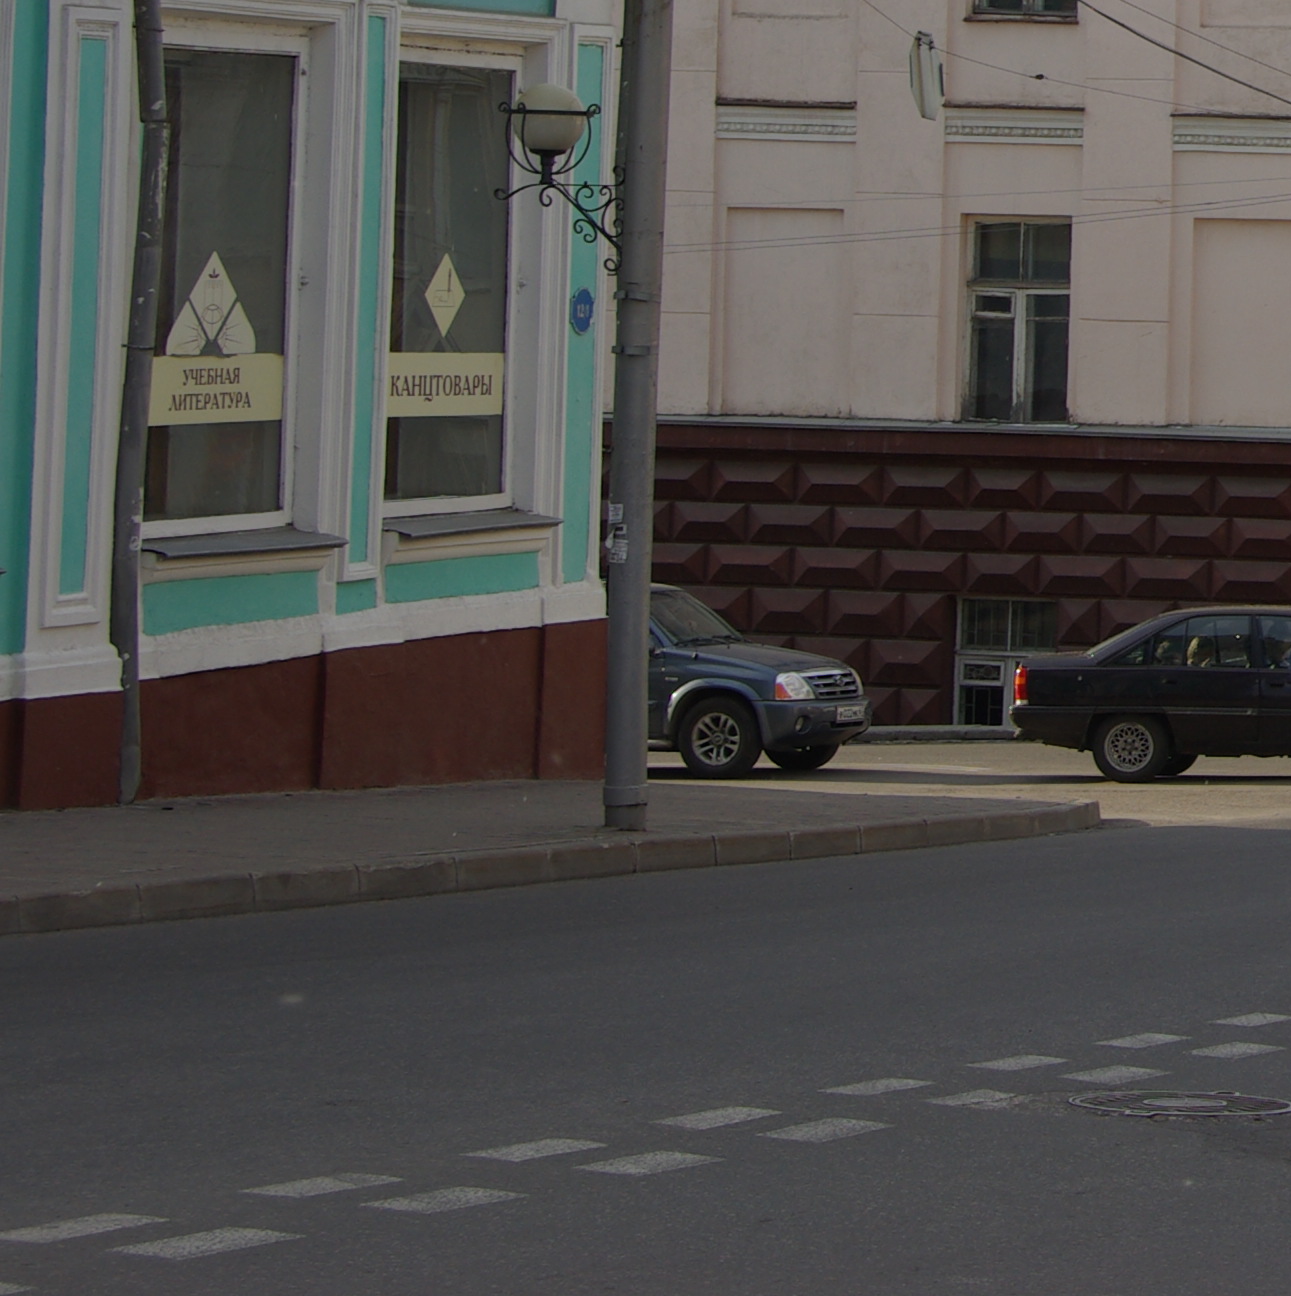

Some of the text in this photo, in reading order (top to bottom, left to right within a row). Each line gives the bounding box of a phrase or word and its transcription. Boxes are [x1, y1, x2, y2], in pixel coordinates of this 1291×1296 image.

[182, 367, 241, 386] УЧЕБНАЯ
[390, 374, 493, 402] КАНЦТОВАРЫ
[168, 391, 252, 412] ЛИТЕРАТУРА
